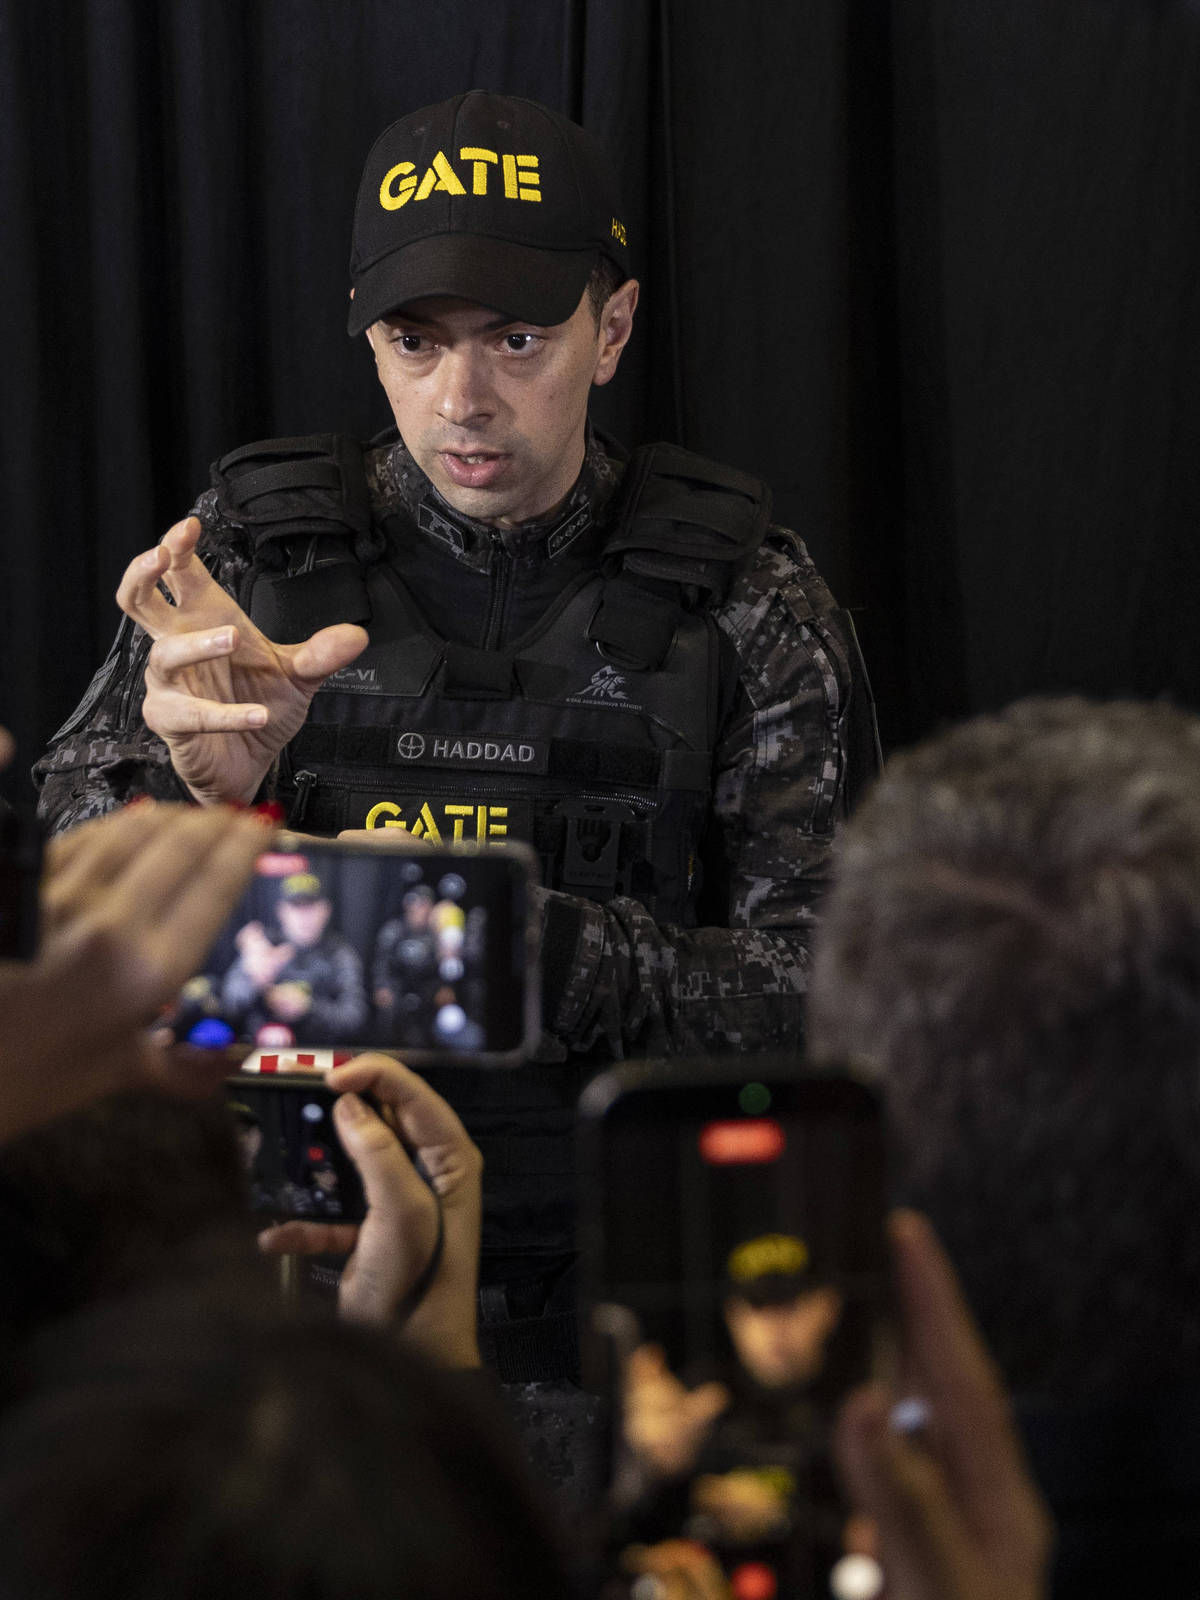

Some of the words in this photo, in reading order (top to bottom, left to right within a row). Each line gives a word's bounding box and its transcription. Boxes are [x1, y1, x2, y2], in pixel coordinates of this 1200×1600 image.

[379, 147, 542, 211] GATE
[432, 739, 536, 762] HADDAD
[365, 801, 509, 848] GATE
